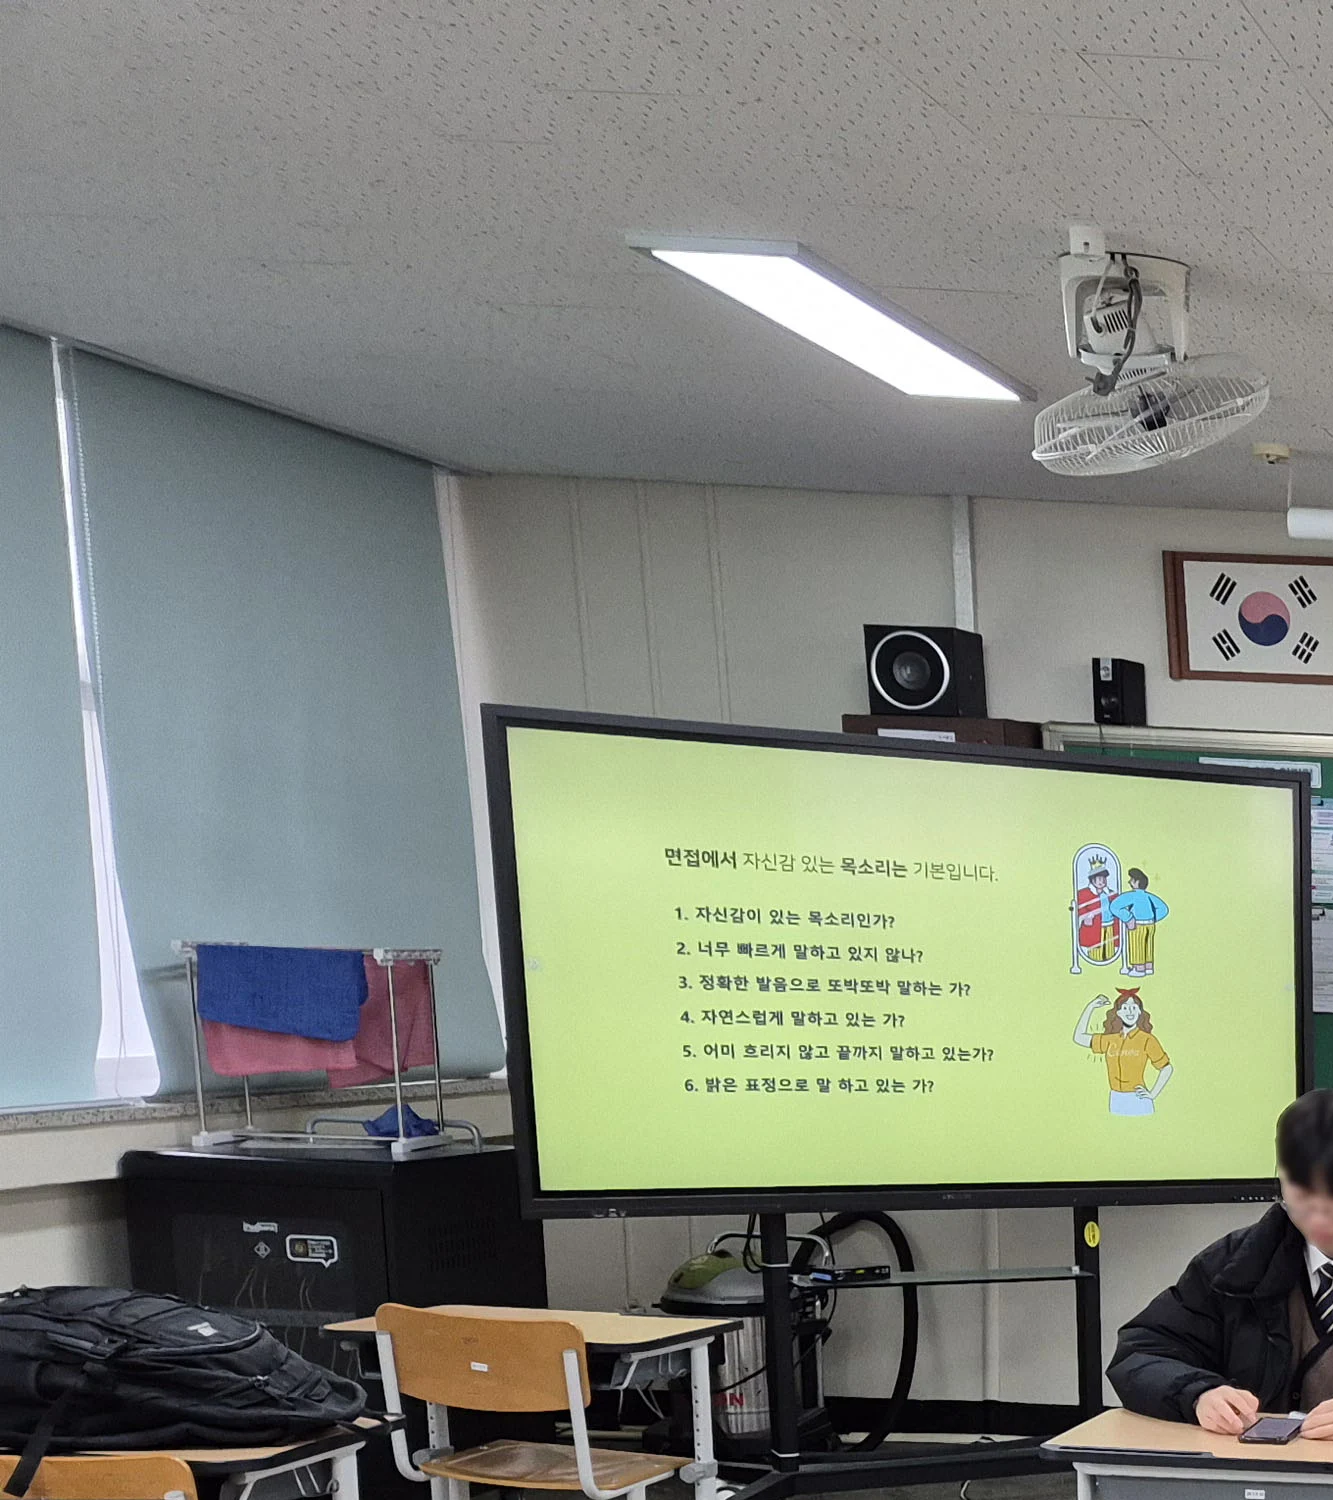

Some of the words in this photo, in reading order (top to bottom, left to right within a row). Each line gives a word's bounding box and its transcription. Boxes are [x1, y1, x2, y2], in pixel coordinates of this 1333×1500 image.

[665, 848, 737, 870] 면접에서
[743, 852, 796, 872] 자신감
[802, 856, 835, 874] 있는
[840, 858, 908, 878] 목소리는
[914, 862, 998, 882] 기본입니다.
[675, 907, 688, 920] 1.
[696, 906, 760, 924] 자신감이
[770, 910, 801, 925] 있는
[808, 911, 894, 929] 목소리인가?
[677, 942, 690, 955] 2.
[698, 941, 730, 957] 너무
[737, 942, 785, 959] 빠르게
[794, 944, 841, 960] 말하고
[848, 946, 877, 962] 있지
[885, 948, 923, 963] 않나?
[679, 976, 692, 989] 3.
[699, 974, 749, 991] 정확한
[756, 976, 820, 992] 발음으로
[828, 978, 891, 995] 또박또박
[897, 980, 942, 996] 말하는
[950, 982, 970, 997] 가?
[680, 1011, 694, 1023] 4.
[701, 1009, 783, 1026] 자연스럽게
[791, 1011, 838, 1027] 말하고
[846, 1012, 876, 1027] 있는
[883, 1013, 905, 1028] 가?
[683, 1045, 696, 1057] 5.
[704, 1043, 734, 1059] 어미
[744, 1044, 790, 1059] 흐리지
[799, 1044, 830, 1060] 않고
[836, 1045, 882, 1061] 끝까지
[890, 1046, 935, 1061] 말하고
[942, 1047, 993, 1062] 있는가?
[685, 1079, 698, 1091] 6.
[706, 1077, 737, 1092] 밝은
[745, 1077, 809, 1093] 표정으로
[817, 1078, 831, 1093] 말
[838, 1078, 869, 1093] 하고
[876, 1079, 905, 1093] 있는
[913, 1079, 934, 1093] 가?
